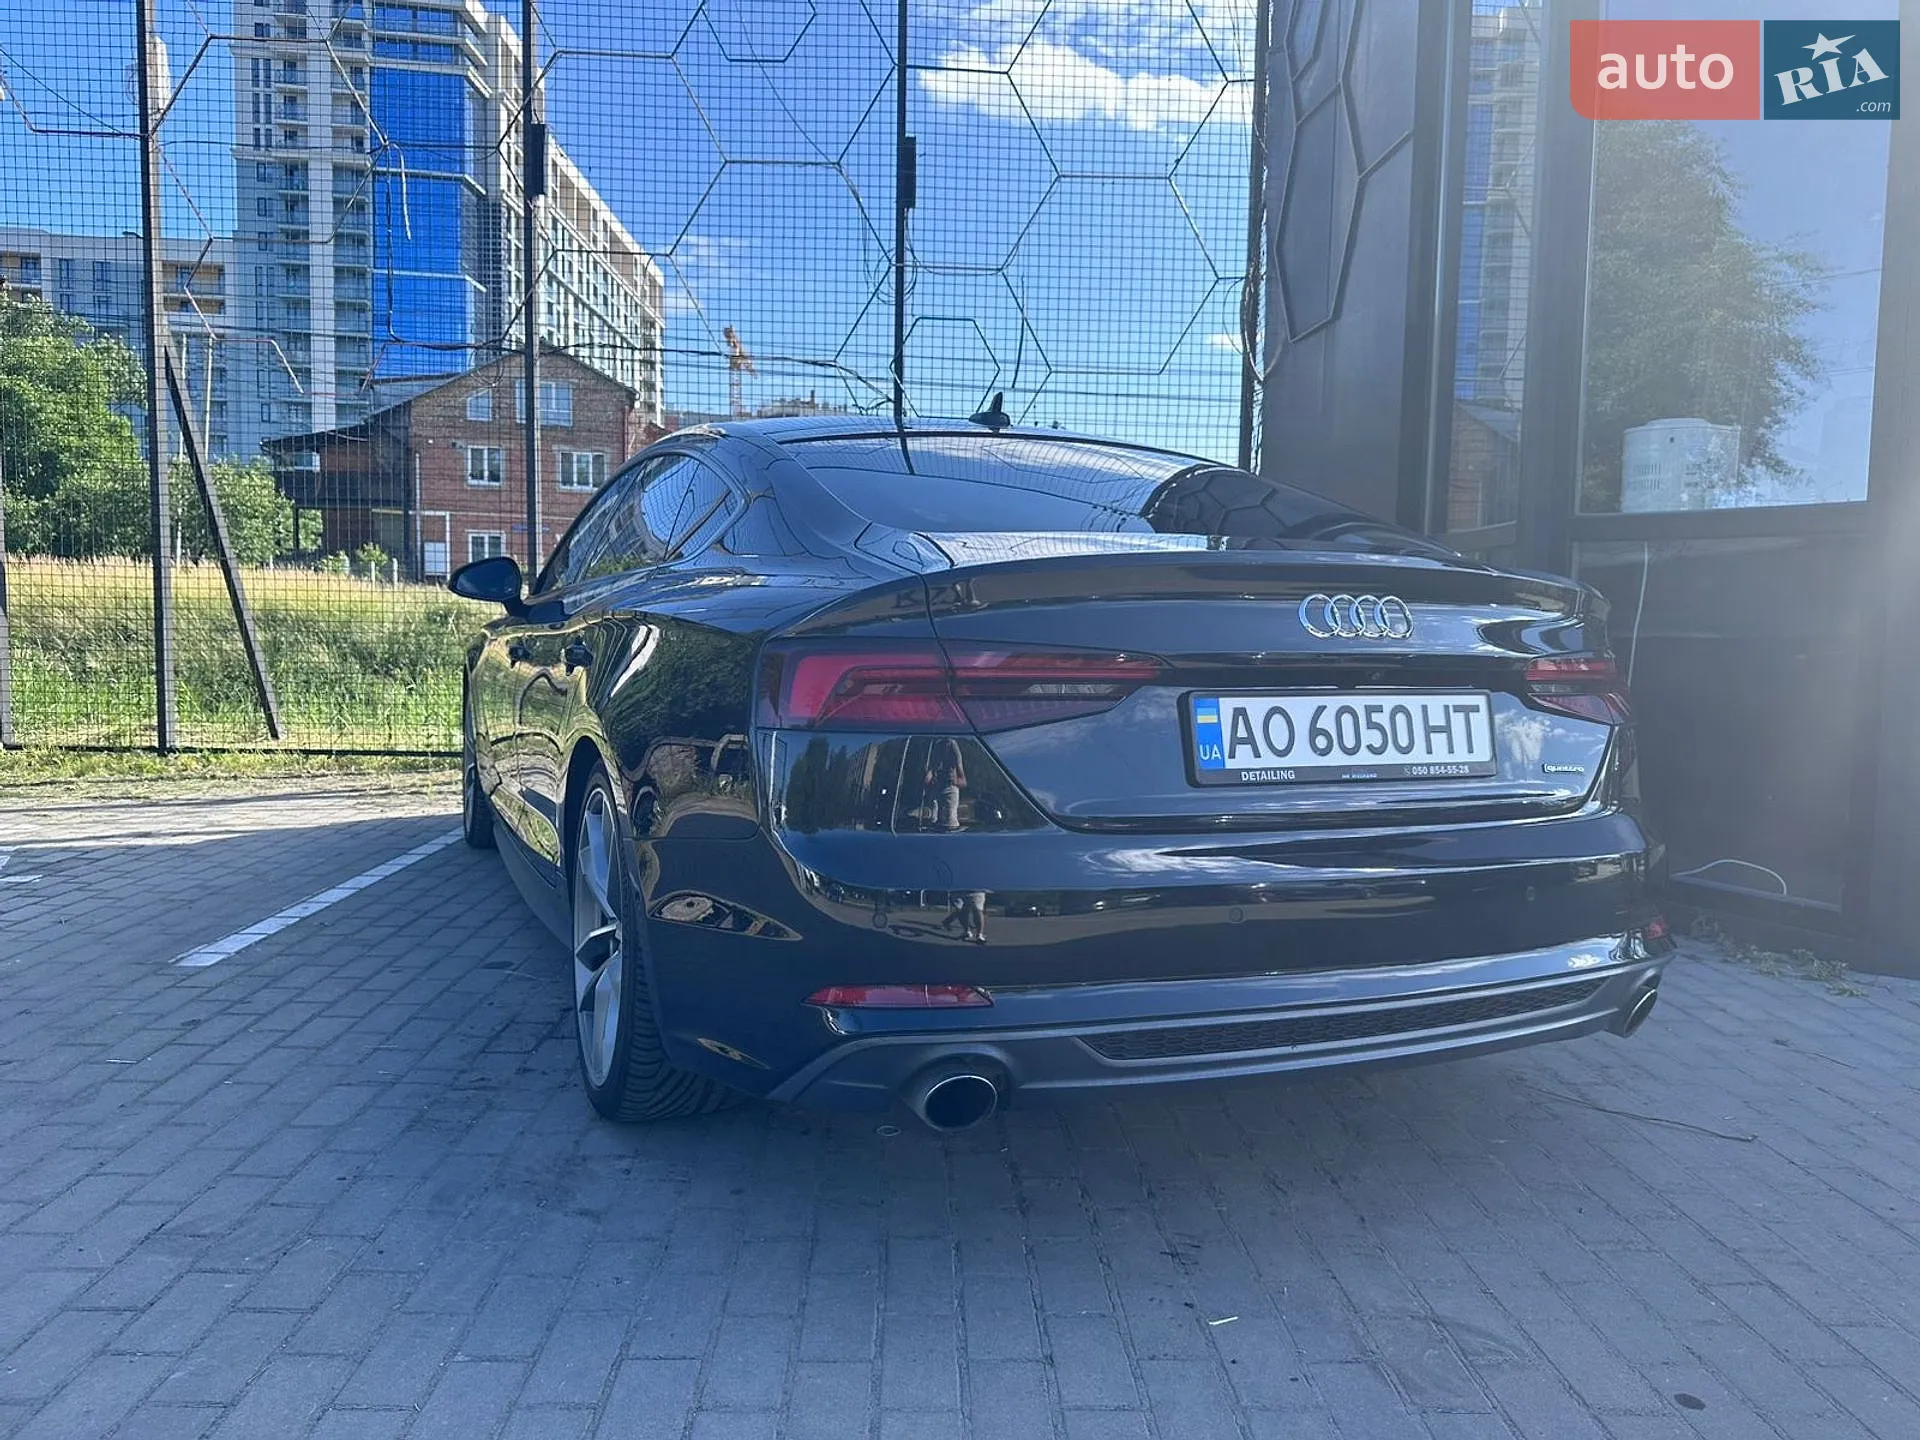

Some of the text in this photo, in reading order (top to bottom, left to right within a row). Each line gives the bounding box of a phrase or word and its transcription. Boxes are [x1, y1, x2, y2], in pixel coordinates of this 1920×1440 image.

[1228, 704, 1480, 759] AO 6050 HT
[1200, 746, 1222, 761] UA
[1241, 770, 1295, 781] DETAILING
